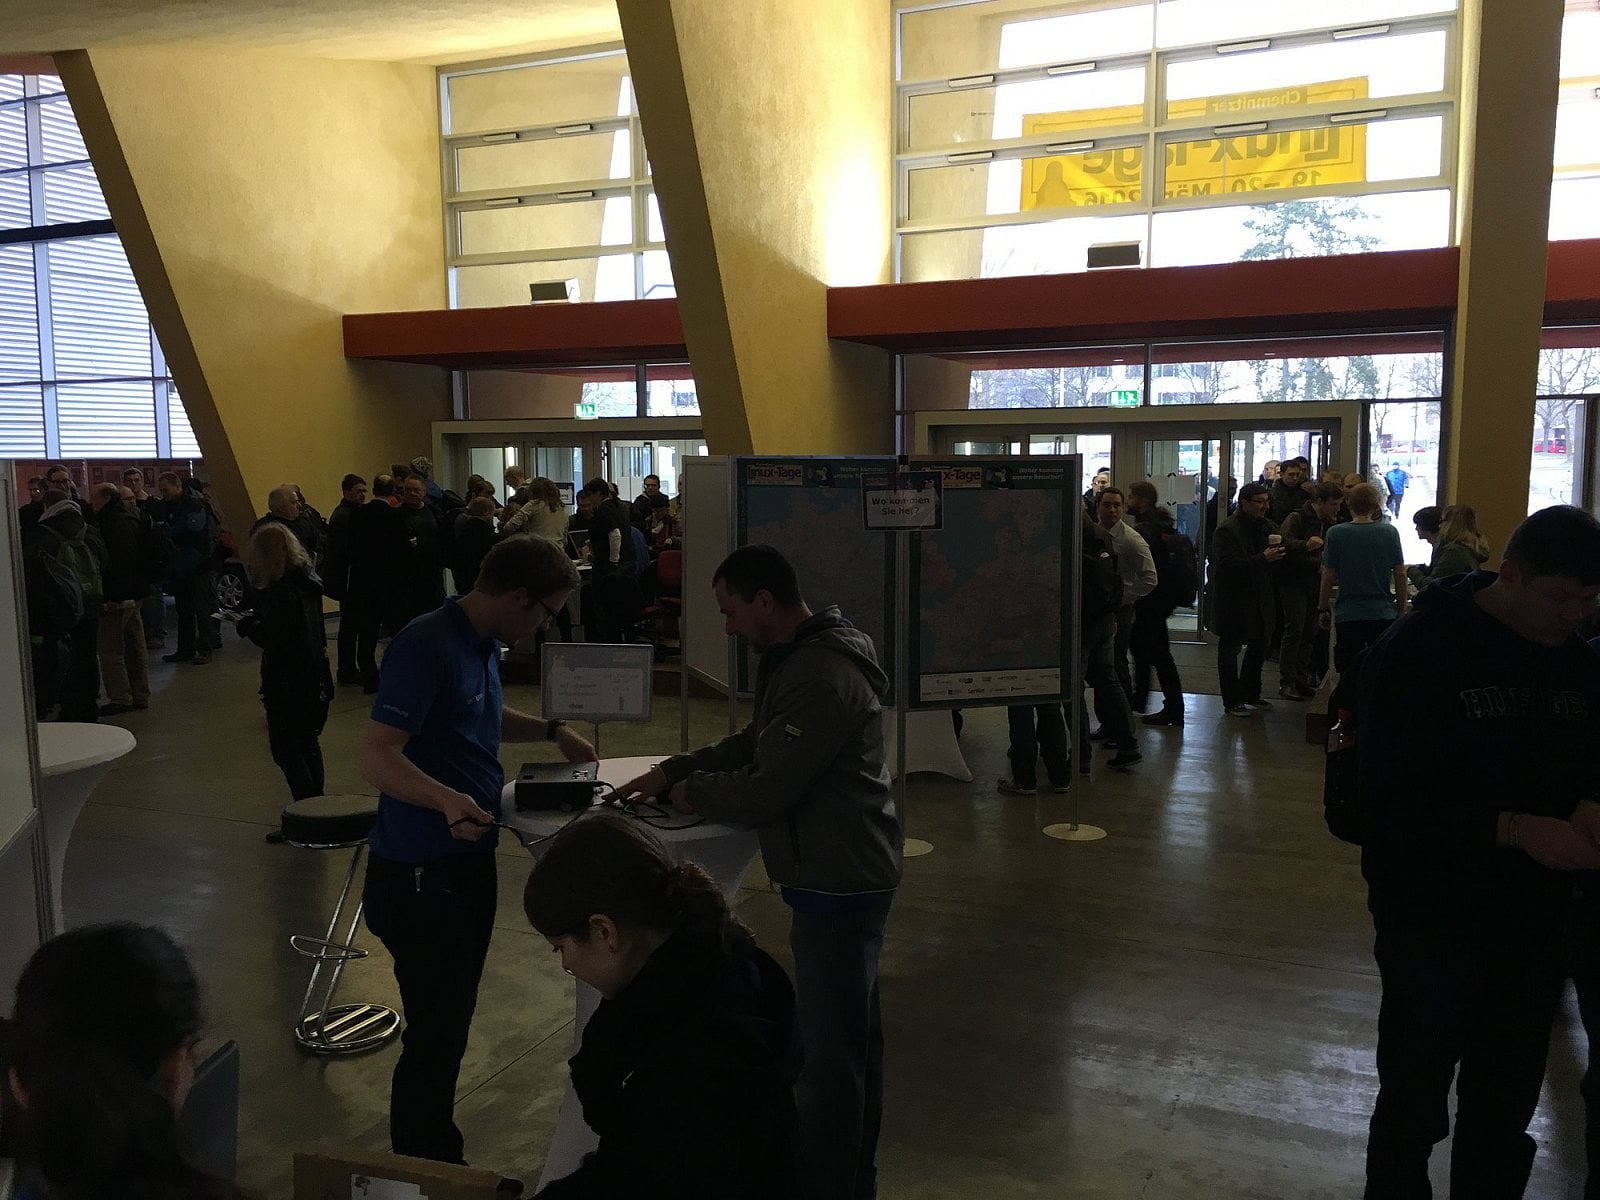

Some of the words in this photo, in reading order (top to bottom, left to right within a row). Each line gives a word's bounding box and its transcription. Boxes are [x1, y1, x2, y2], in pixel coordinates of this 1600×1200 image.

[943, 469, 981, 482] x-Tage
[871, 497, 887, 505] Wo
[881, 507, 896, 515] Sie
